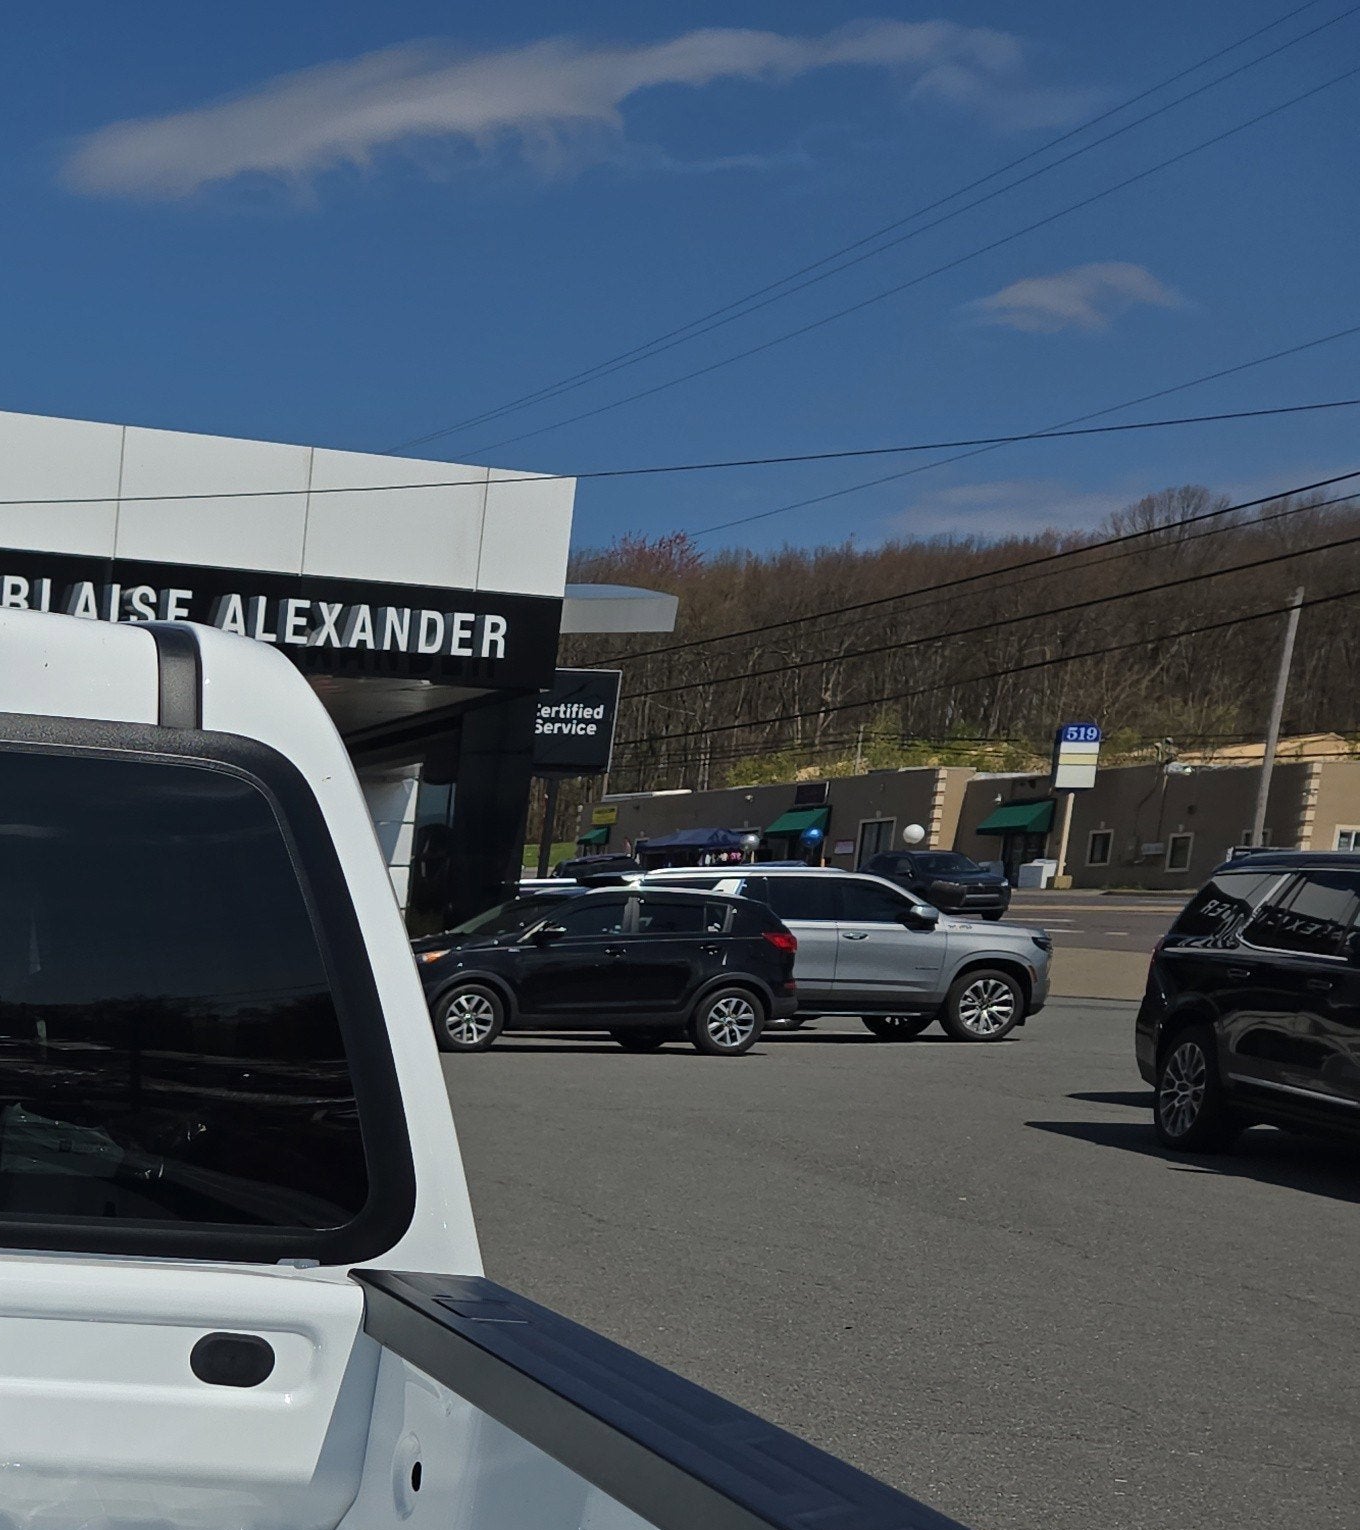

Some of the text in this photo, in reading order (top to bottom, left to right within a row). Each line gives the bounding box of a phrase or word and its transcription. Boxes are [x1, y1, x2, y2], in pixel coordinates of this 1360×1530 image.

[1, 574, 508, 659] BLAISE ALEXANDER
[1066, 726, 1098, 740] 519
